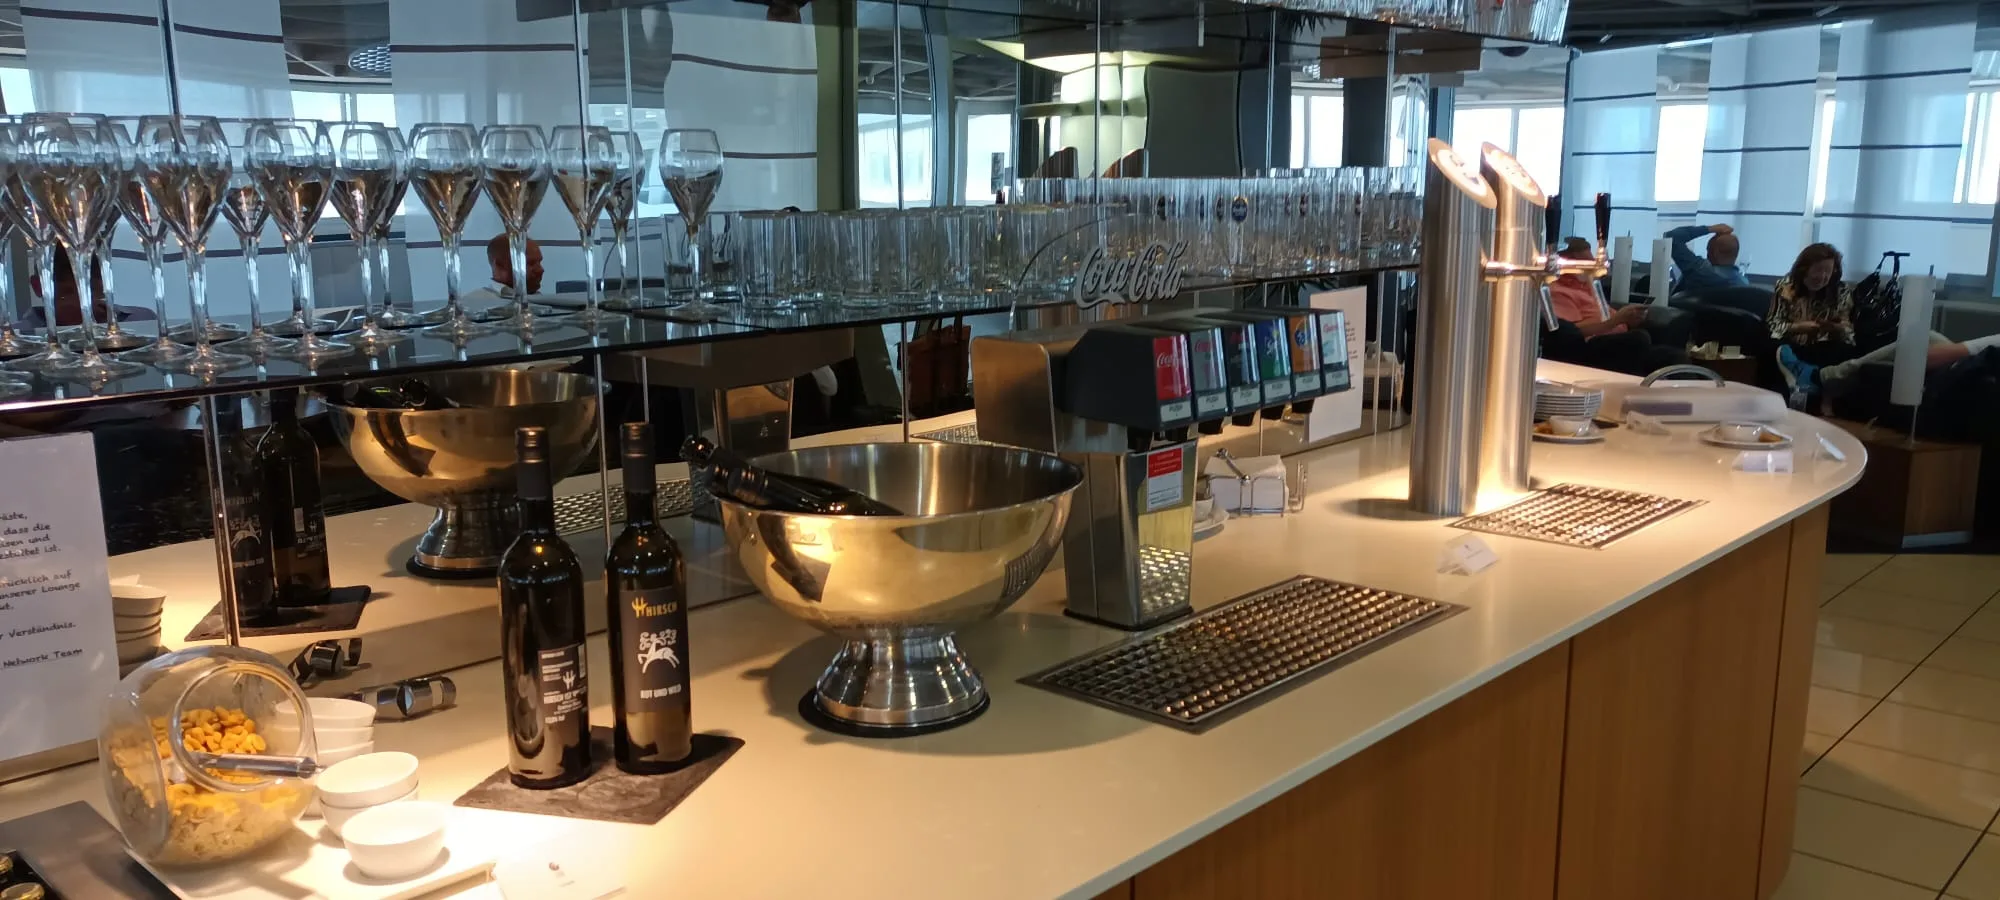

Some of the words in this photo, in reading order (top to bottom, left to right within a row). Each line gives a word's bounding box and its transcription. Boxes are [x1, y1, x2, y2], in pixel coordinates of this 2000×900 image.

[4, 527, 28, 535] dass
[33, 522, 50, 531] die
[28, 534, 50, 543] und
[53, 569, 72, 580] auf
[41, 582, 80, 593] Lounge
[4, 654, 48, 668] Network
[53, 648, 83, 659] Team
